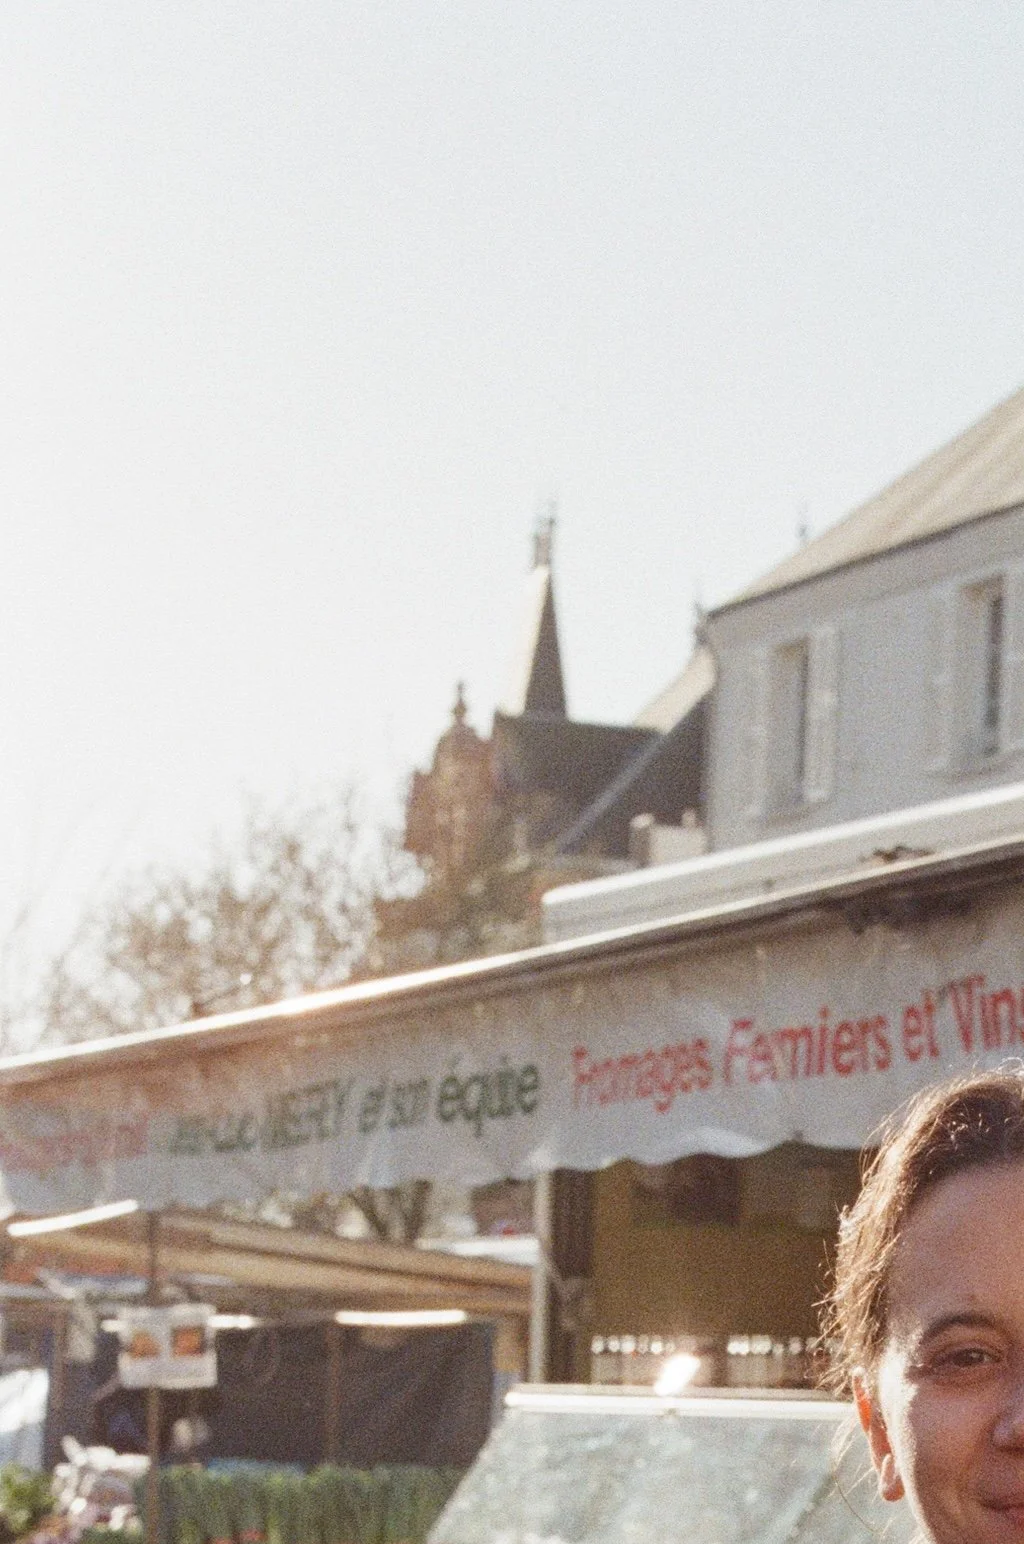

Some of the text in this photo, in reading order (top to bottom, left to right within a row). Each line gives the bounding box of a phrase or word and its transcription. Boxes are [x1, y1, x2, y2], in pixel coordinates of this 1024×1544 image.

[437, 1052, 540, 1138] équie
[571, 1037, 713, 1115] Fromages
[903, 989, 940, 1062] et
